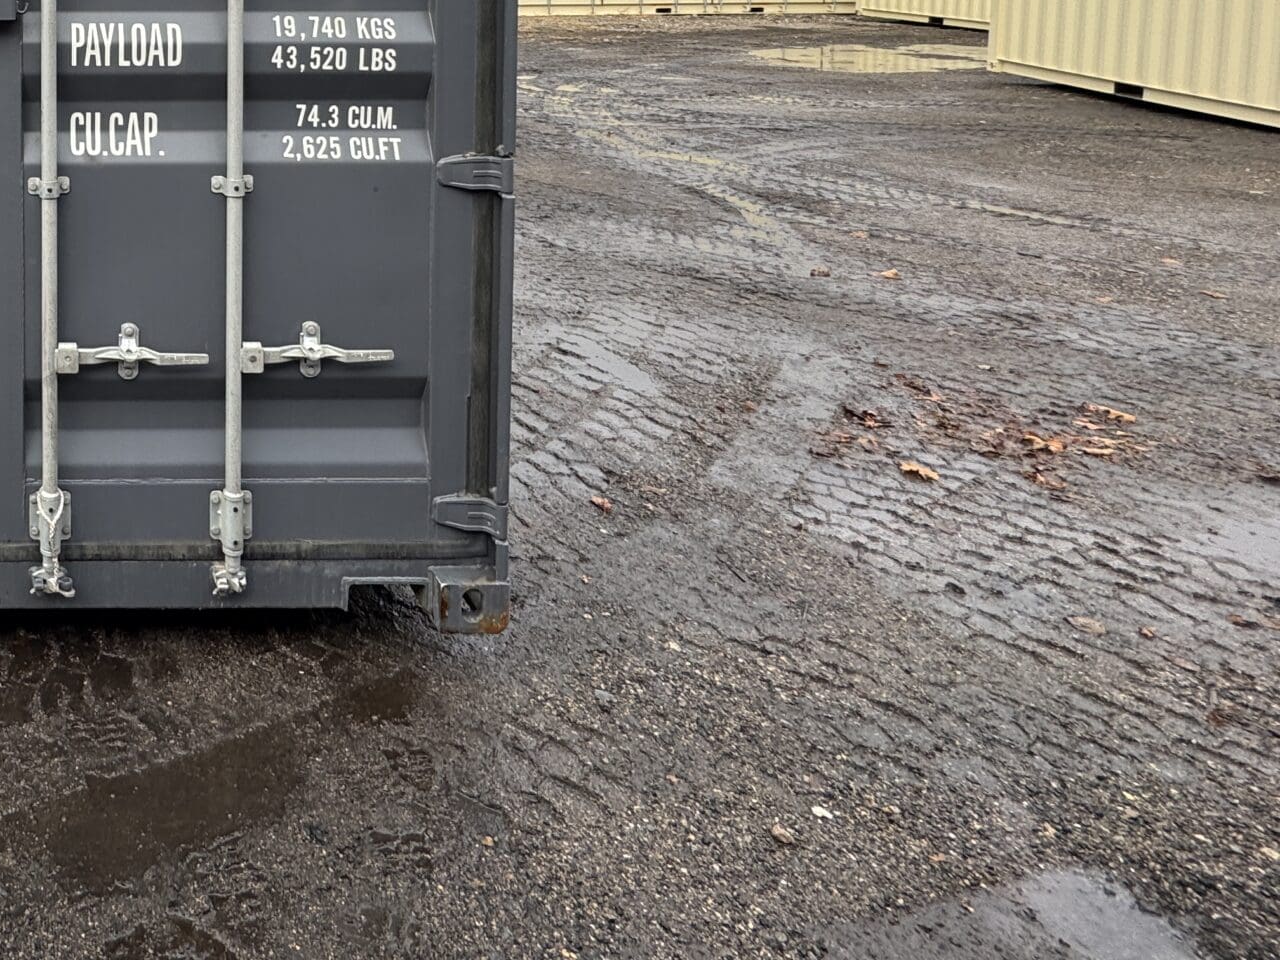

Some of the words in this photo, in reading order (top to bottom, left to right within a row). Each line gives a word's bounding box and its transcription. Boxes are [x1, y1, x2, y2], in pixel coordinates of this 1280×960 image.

[271, 14, 347, 41] 19,740
[355, 16, 397, 40] KGS
[70, 22, 183, 68] PAYLOAD
[271, 45, 348, 73] 43,520
[358, 46, 397, 72] LBS
[295, 103, 340, 129] 74.3
[347, 104, 398, 130] CU.M.
[69, 111, 166, 157] CU.CAP.
[281, 135, 342, 163] 2,625
[348, 136, 402, 161] CU.FT
